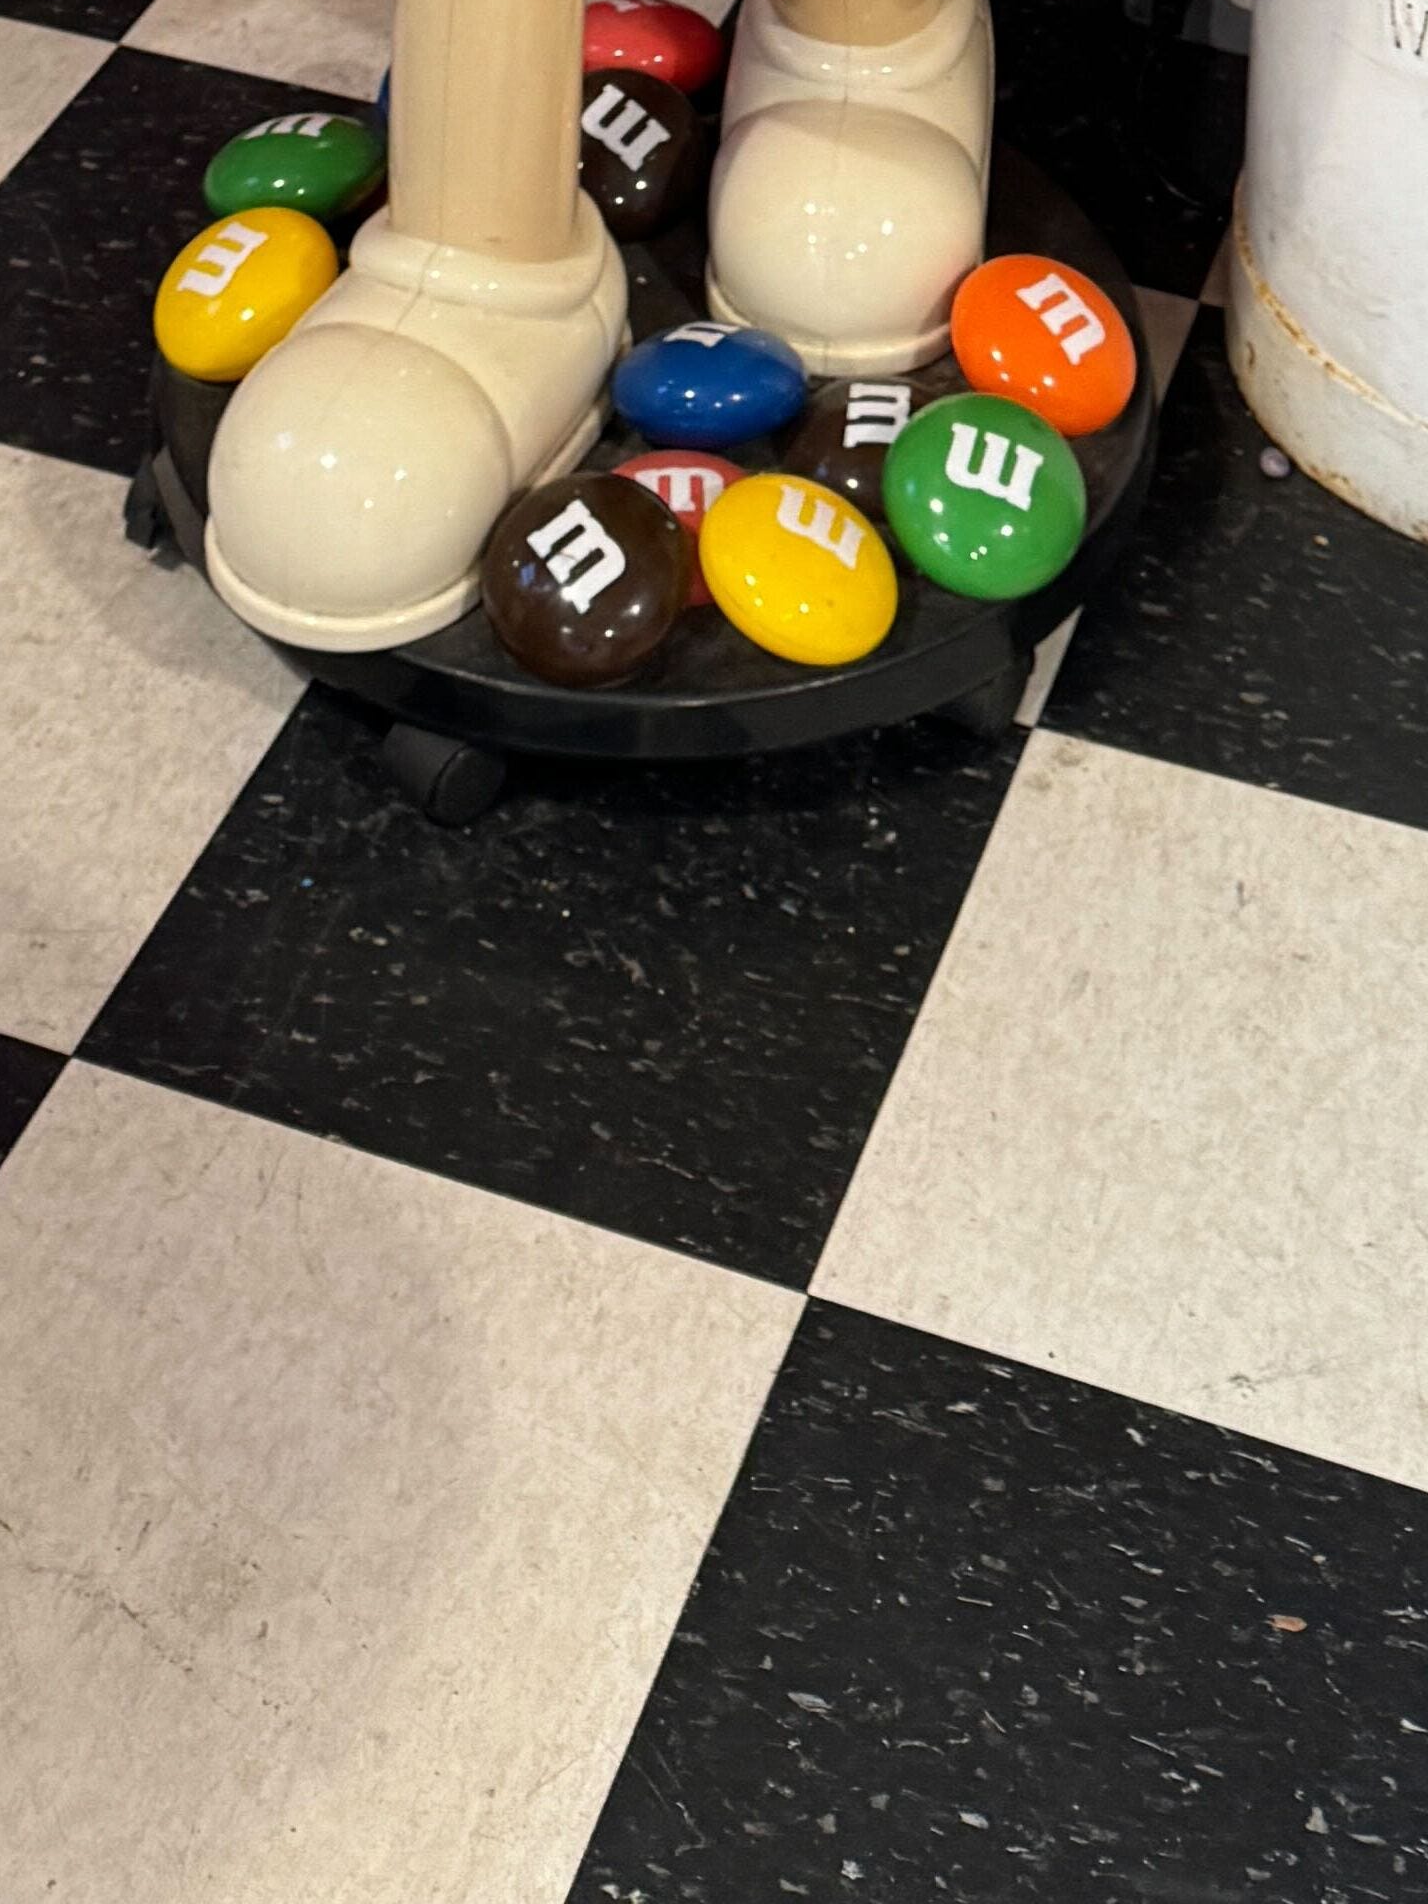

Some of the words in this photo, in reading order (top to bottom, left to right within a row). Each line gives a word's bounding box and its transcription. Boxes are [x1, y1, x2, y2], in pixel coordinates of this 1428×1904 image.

[581, 81, 671, 174] m
[176, 220, 270, 300] m
[1016, 271, 1109, 366] m
[844, 381, 913, 451] m
[943, 420, 1046, 512] m
[525, 497, 629, 615] m
[774, 483, 868, 571] m
